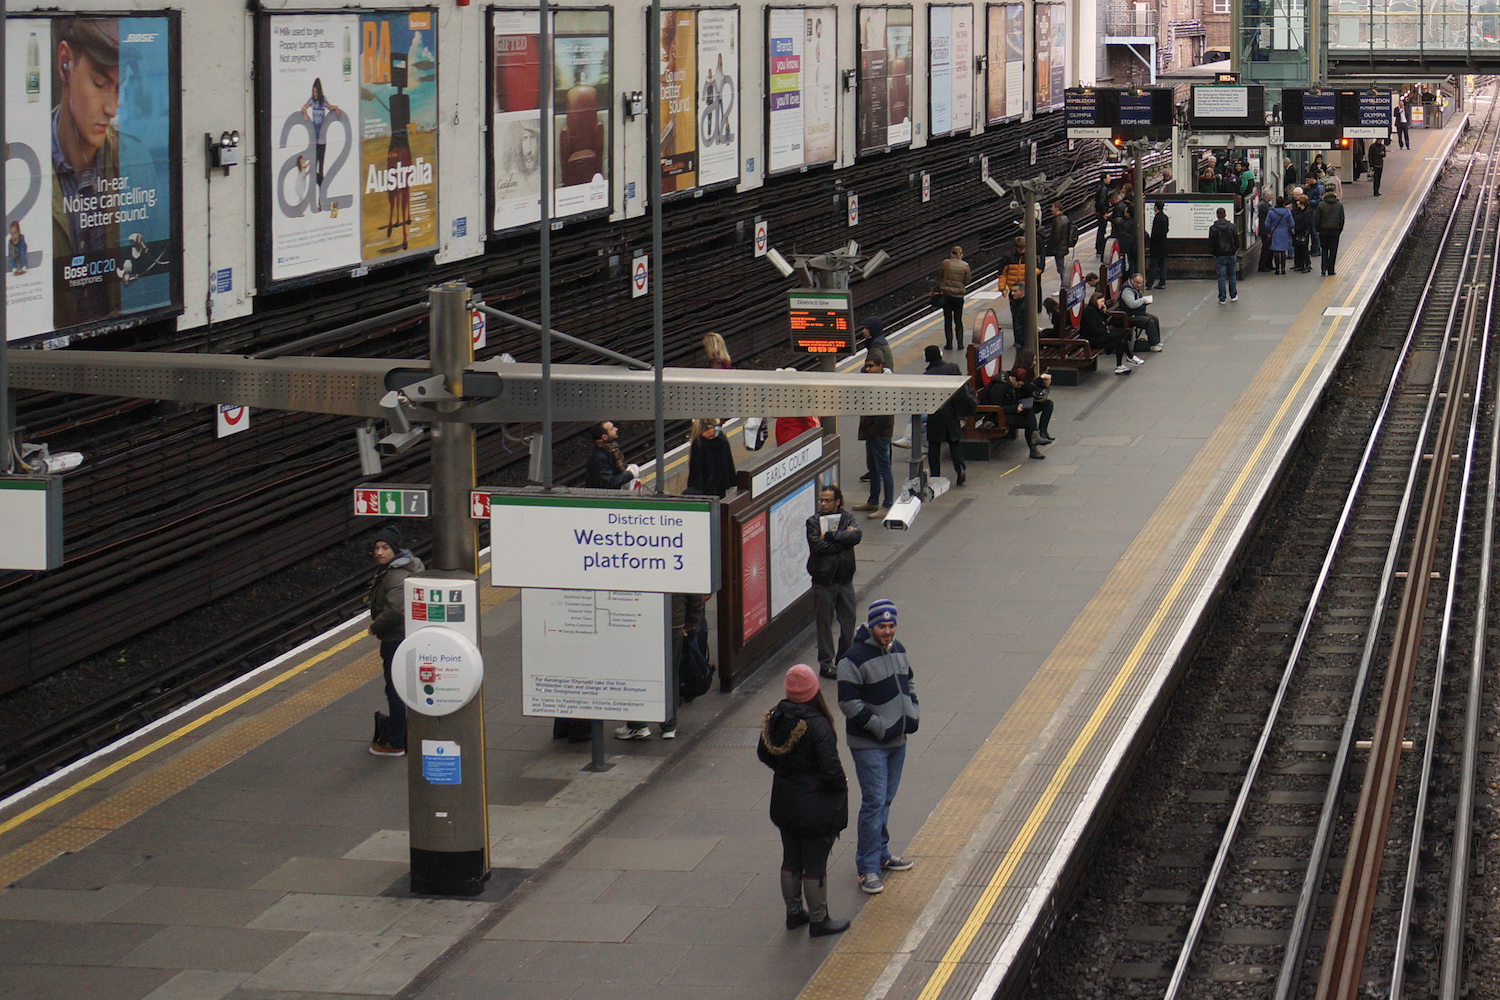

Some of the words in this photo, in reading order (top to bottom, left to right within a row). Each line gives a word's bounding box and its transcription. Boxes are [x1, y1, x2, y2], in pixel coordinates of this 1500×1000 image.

[122, 33, 158, 42] BOSE
[292, 27, 305, 36] used
[307, 28, 312, 36] to
[313, 28, 324, 37] give
[280, 41, 297, 51] Poppy
[299, 41, 317, 50] tummy
[319, 40, 335, 48] aches.
[363, 20, 391, 84] RA
[496, 36, 527, 52] GIFTED
[777, 40, 792, 52] Brands
[777, 60, 785, 72] you
[787, 58, 799, 69] know.
[665, 69, 673, 83] Go
[674, 69, 686, 82] with
[777, 77, 797, 88] Rewards
[660, 84, 682, 100] better
[669, 98, 691, 114] sound.
[776, 94, 789, 108] you'll
[701, 74, 734, 148] a2
[277, 110, 354, 218] a2
[366, 156, 432, 194] Australia
[97, 176, 130, 192] In-ear.
[63, 196, 97, 214] Noise
[100, 188, 158, 208] cancelling.
[80, 211, 114, 229] Better
[115, 205, 149, 222] sound.
[64, 266, 88, 280] Bose
[70, 275, 103, 287] headphones
[978, 344, 989, 361] EARL'S
[990, 338, 1001, 355] COURT
[766, 465, 787, 486] EARL'S
[789, 448, 809, 472] COURT
[608, 513, 655, 526] District
[660, 515, 683, 526] line
[574, 528, 683, 548] Westbound
[584, 552, 665, 571] platform
[673, 554, 684, 570] 3
[419, 654, 437, 663] Help
